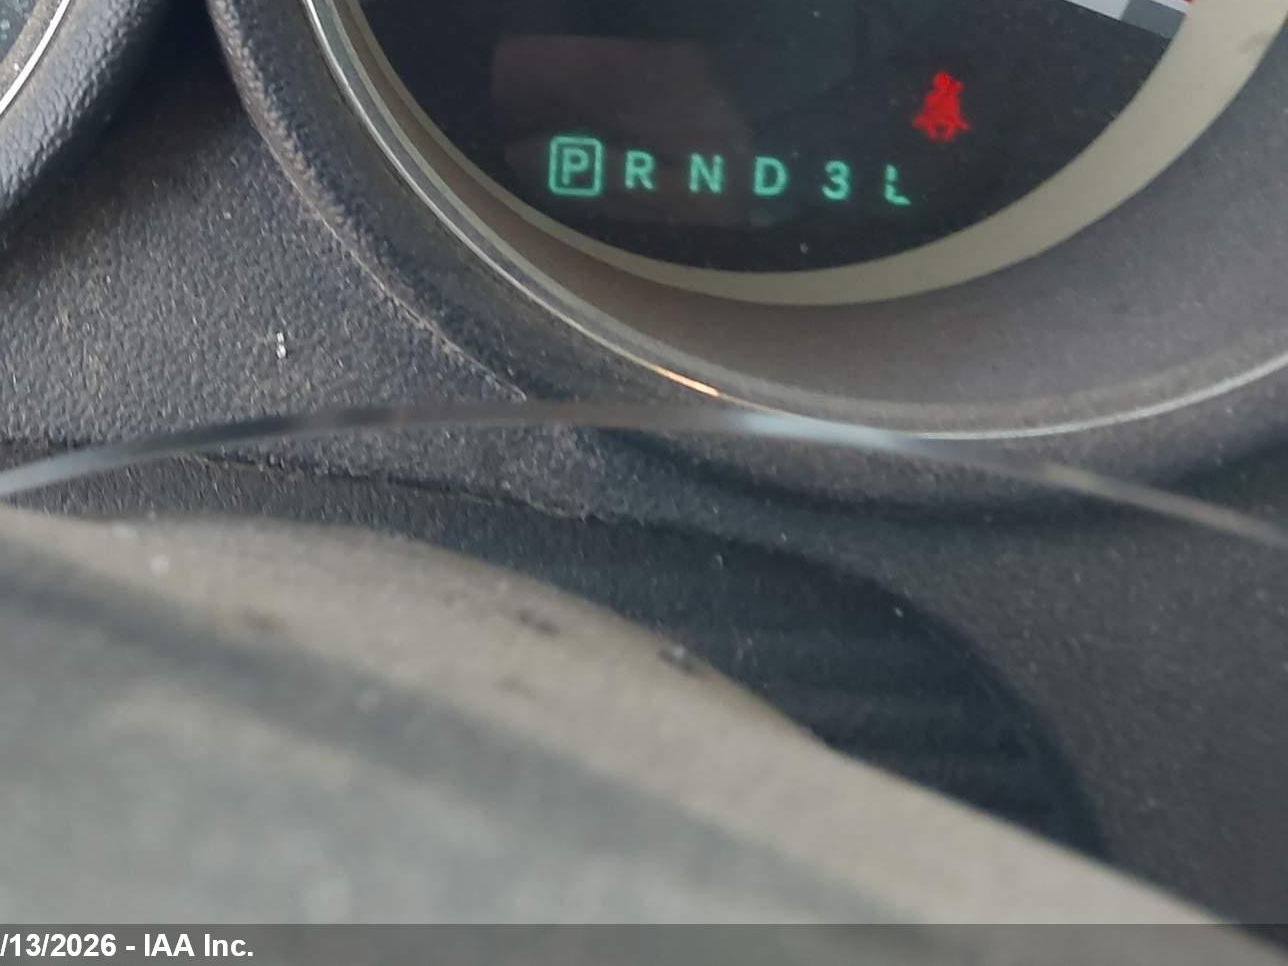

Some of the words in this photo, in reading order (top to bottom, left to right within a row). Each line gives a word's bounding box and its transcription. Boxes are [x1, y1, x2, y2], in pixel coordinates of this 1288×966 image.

[625, 151, 654, 190] R
[689, 155, 722, 194] N
[754, 158, 786, 196] D
[823, 162, 849, 200] 3
[885, 165, 910, 204] L
